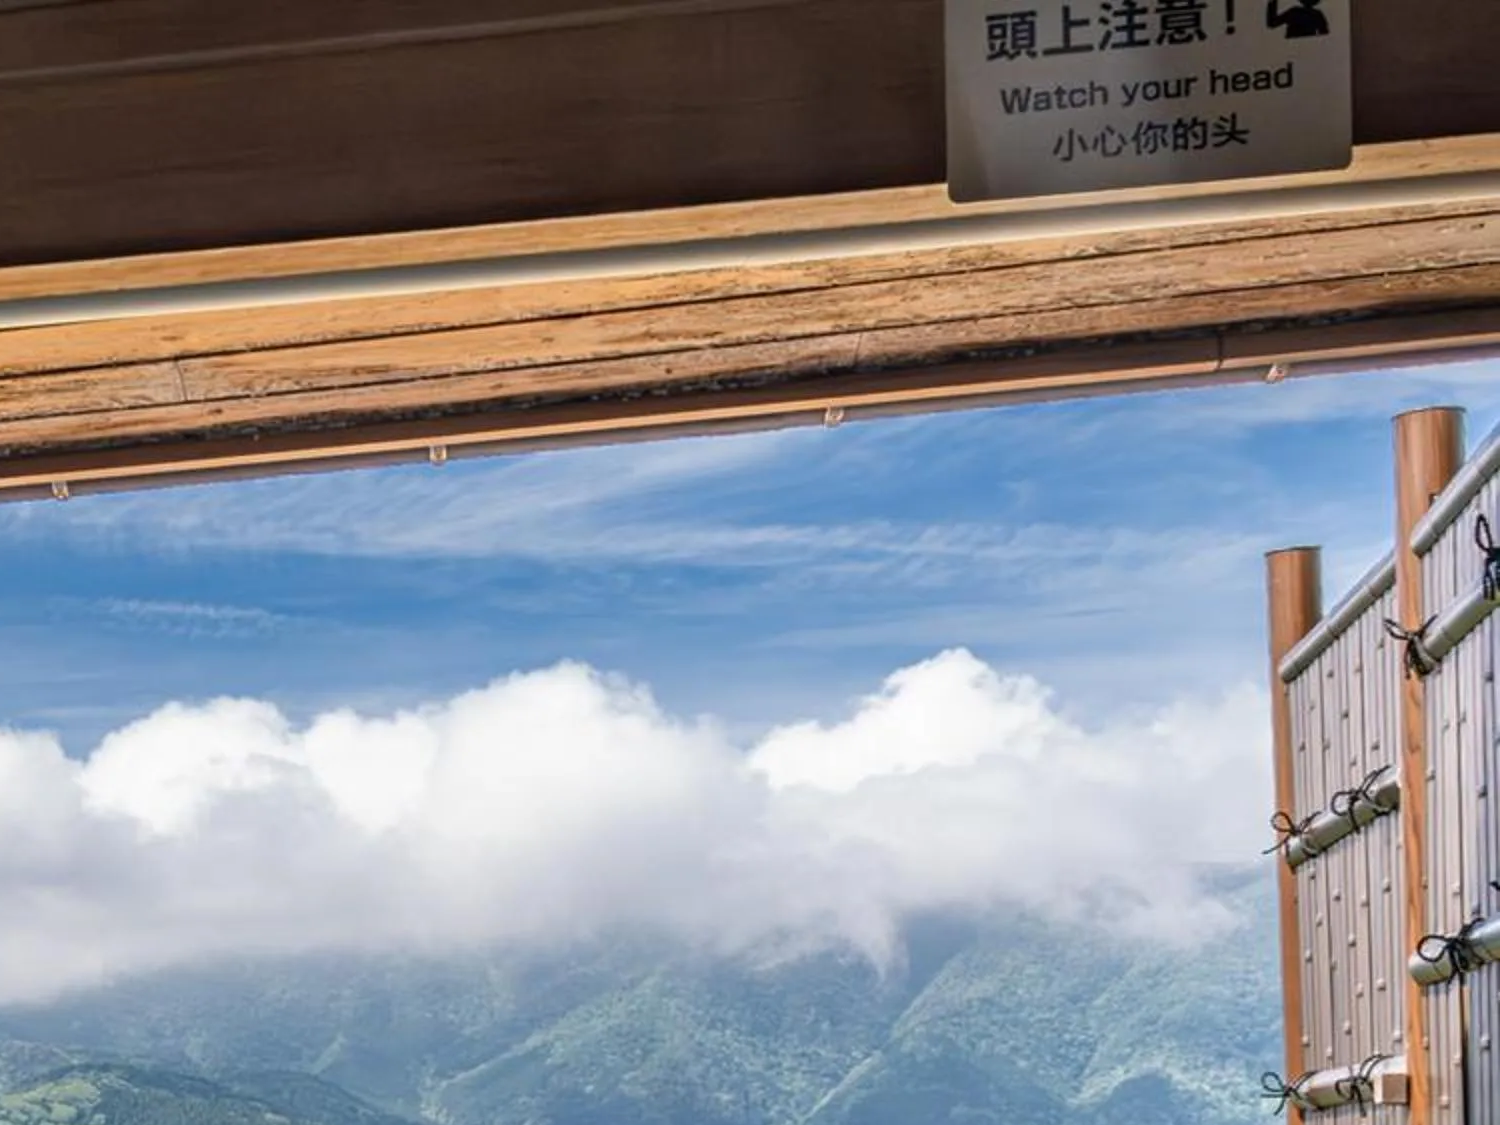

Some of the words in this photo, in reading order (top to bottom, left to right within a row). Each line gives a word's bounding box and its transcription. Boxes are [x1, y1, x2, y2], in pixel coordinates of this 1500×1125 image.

[1000, 81, 1109, 115] Watch
[1121, 75, 1198, 108] your
[1210, 62, 1294, 95] head
[1052, 113, 1250, 162] 小心你的头
